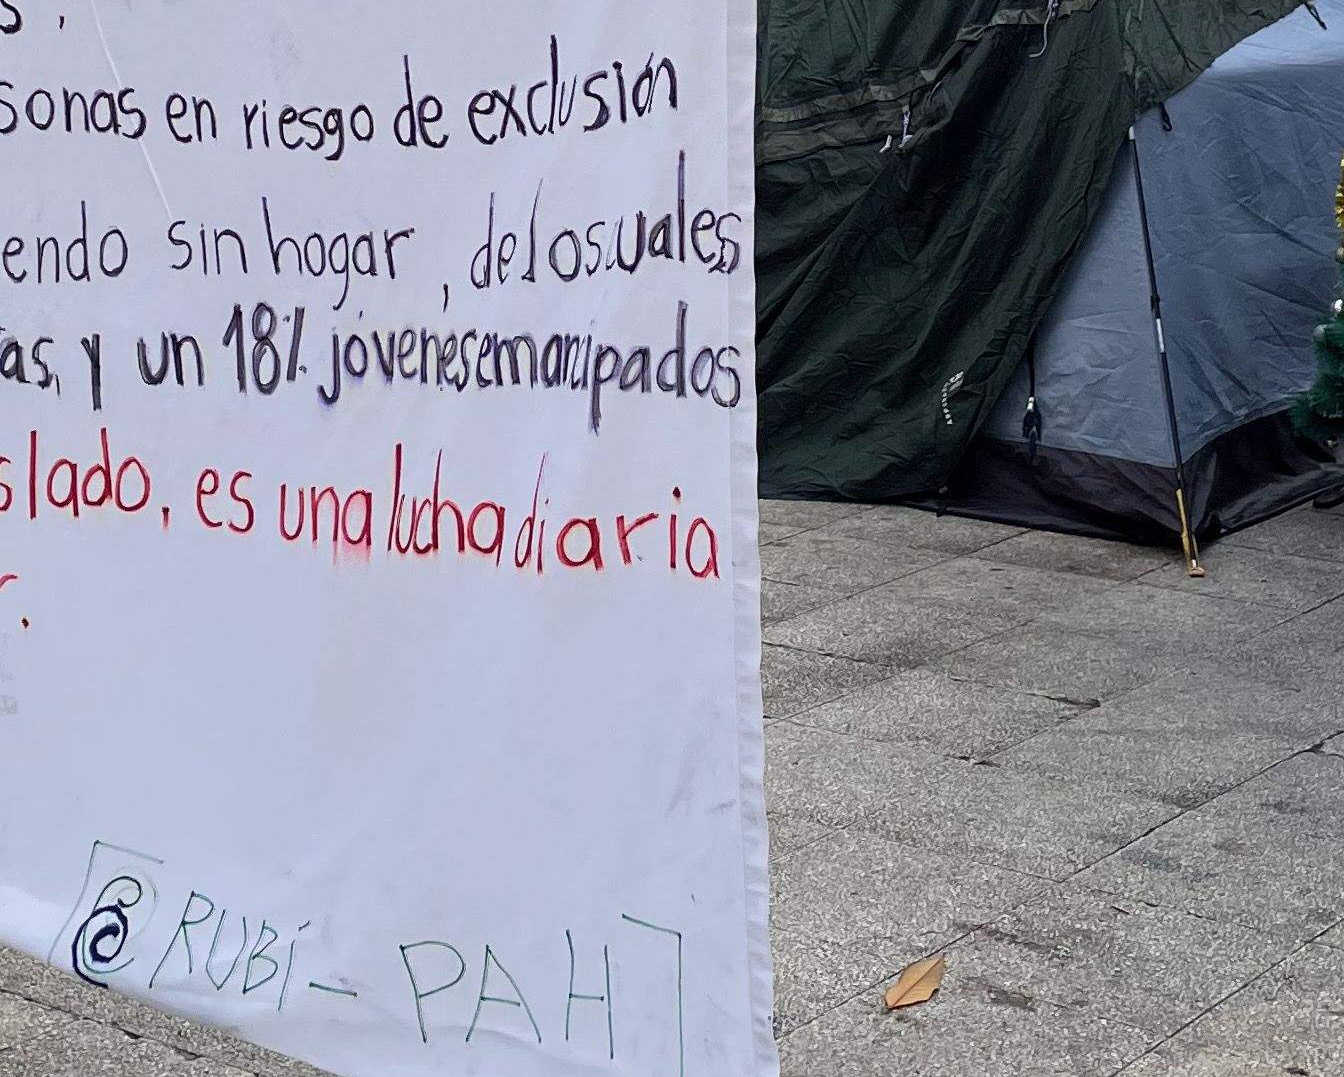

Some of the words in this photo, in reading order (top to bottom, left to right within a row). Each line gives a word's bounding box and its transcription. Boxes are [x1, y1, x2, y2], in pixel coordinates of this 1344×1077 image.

[165, 90, 218, 143] en
[241, 98, 375, 162] riesgo
[393, 54, 450, 150] de
[167, 218, 249, 277] sin
[136, 329, 206, 388] un
[222, 301, 308, 398] 18%
[196, 468, 256, 534] es
